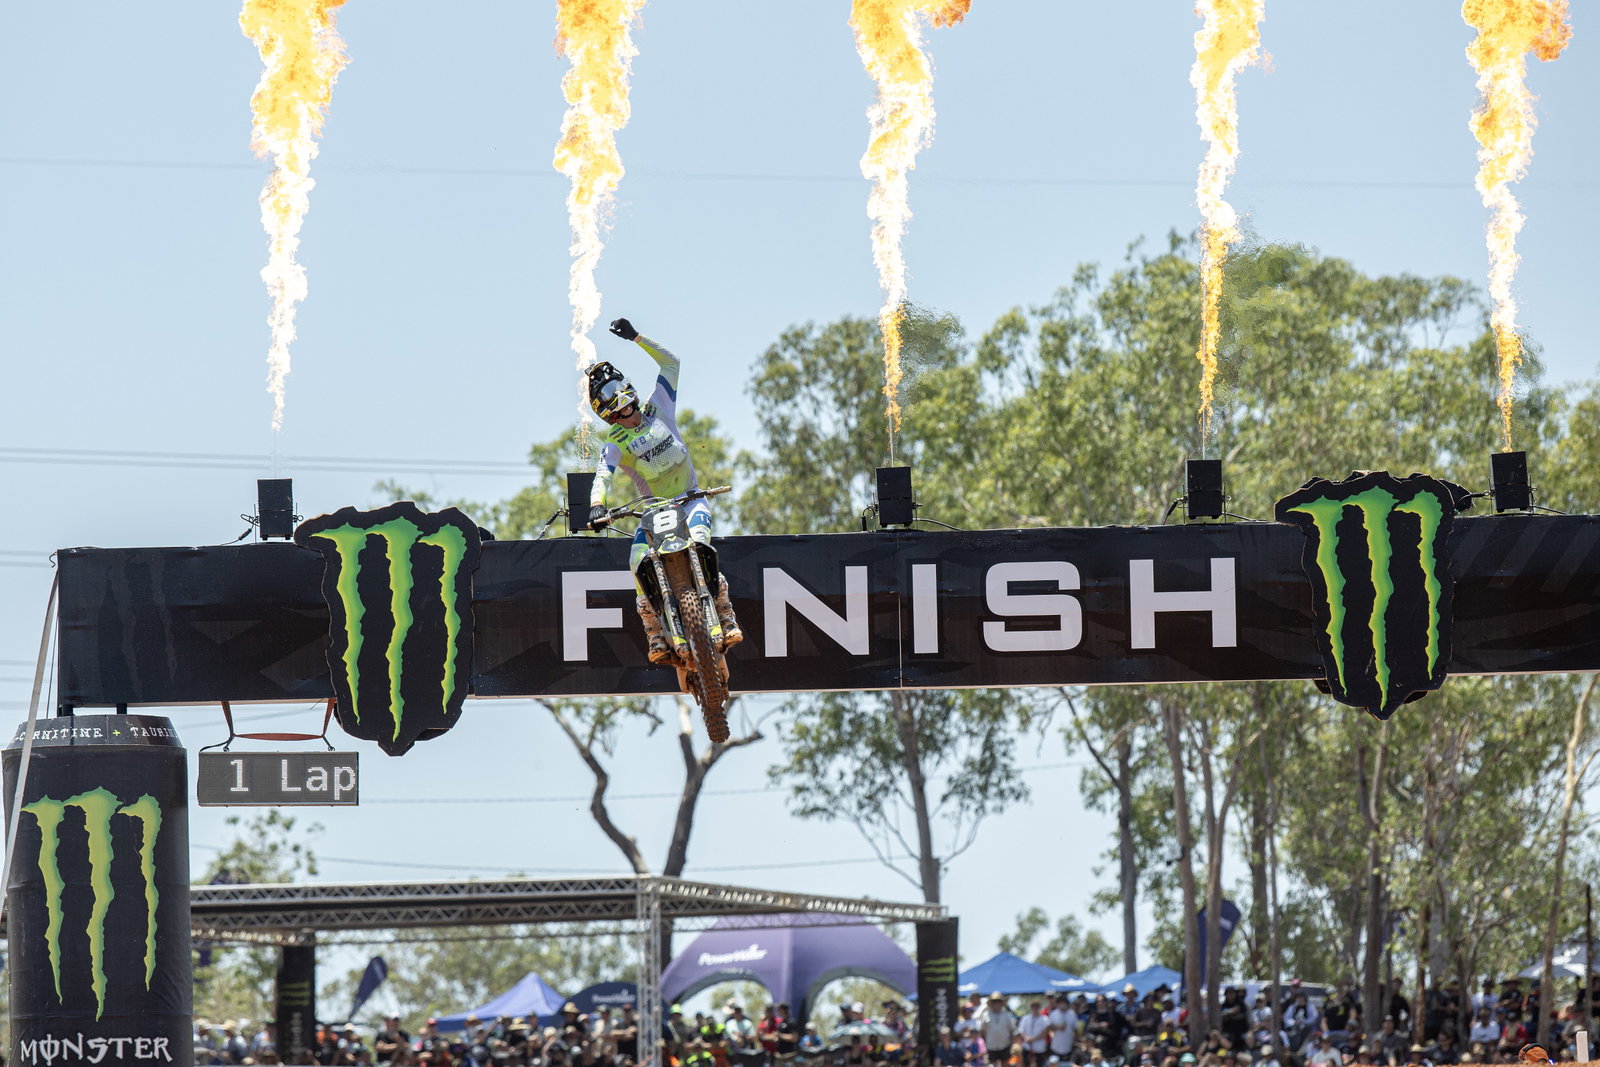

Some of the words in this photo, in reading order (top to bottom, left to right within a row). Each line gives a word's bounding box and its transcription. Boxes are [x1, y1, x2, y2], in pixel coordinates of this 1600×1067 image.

[653, 510, 677, 534] 8
[561, 557, 1237, 662] FNISH
[12, 726, 103, 743] -CRNITINE
[130, 726, 178, 738] TAURIN
[230, 759, 249, 792] 1
[281, 759, 356, 801] Lap
[20, 1032, 173, 1066] MONSTER
